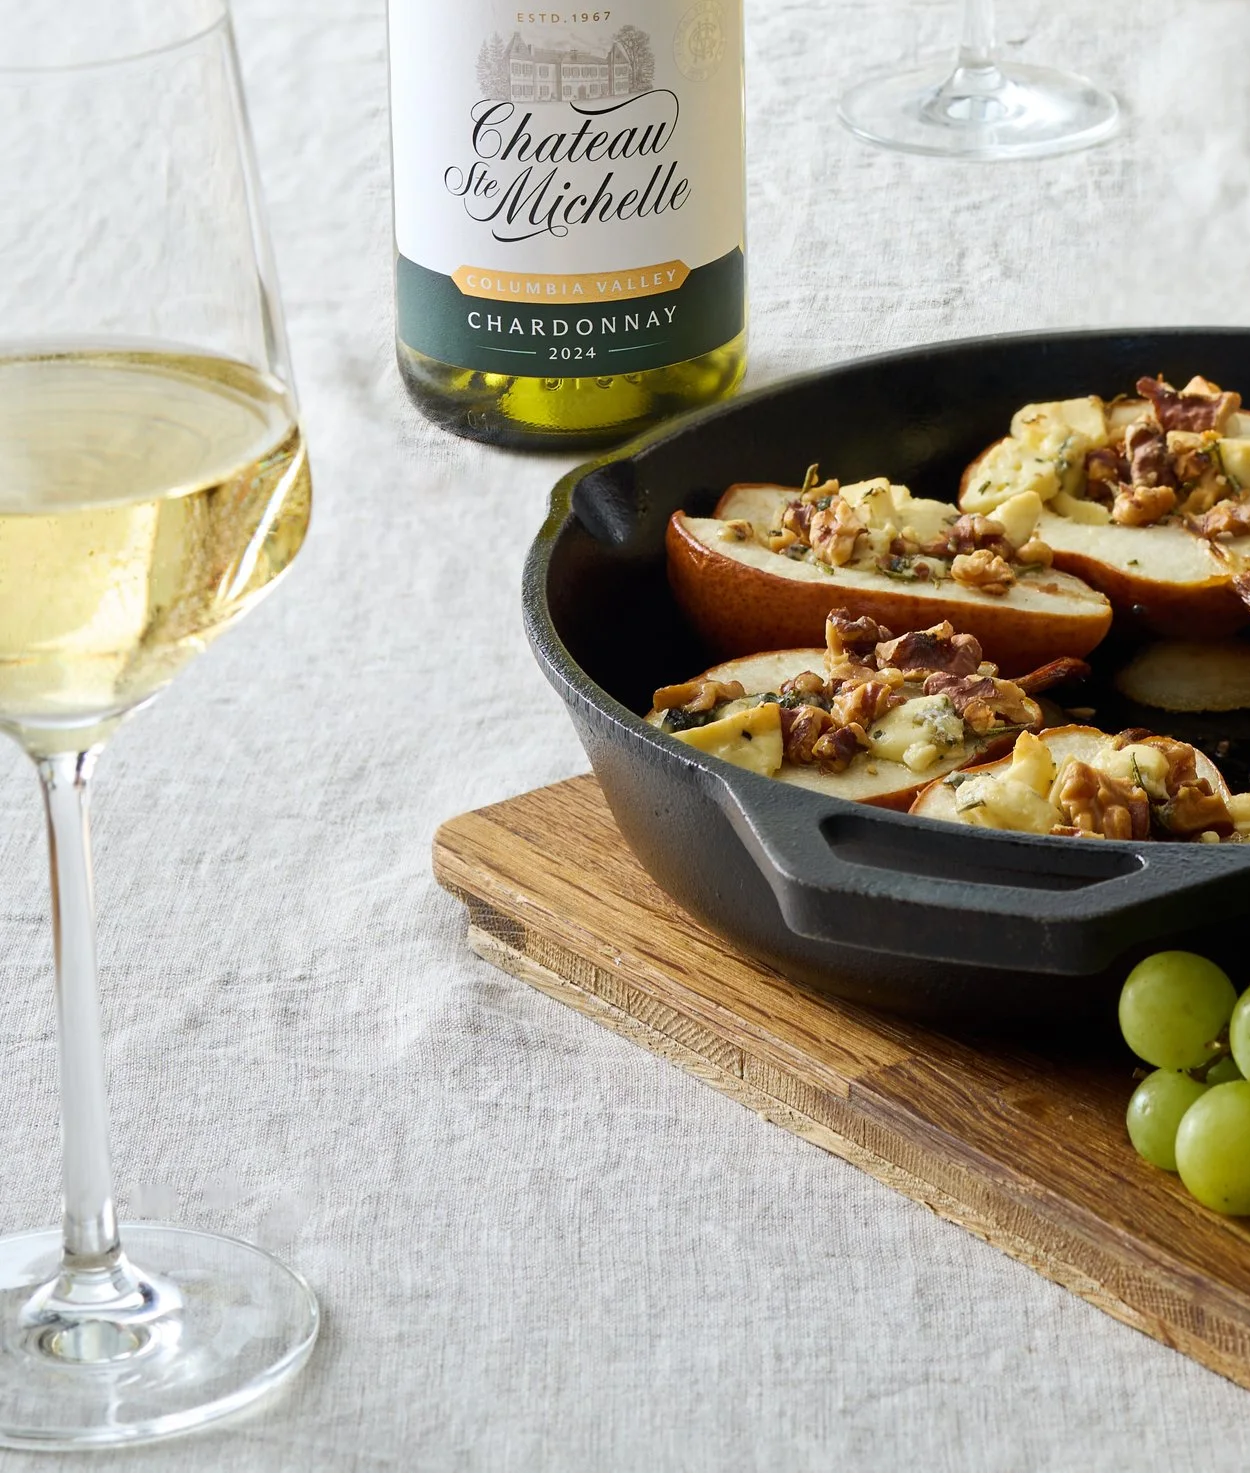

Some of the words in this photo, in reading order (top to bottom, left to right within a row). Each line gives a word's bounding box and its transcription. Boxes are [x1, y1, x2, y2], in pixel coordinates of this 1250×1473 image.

[470, 88, 680, 163] Chateau
[444, 161, 500, 199] Ste
[463, 160, 692, 243] Michelle
[466, 273, 584, 296] COLUMBIA
[596, 269, 676, 293] VALLEY
[467, 305, 677, 337] CHARDONNAY
[548, 347, 597, 361] 2024
